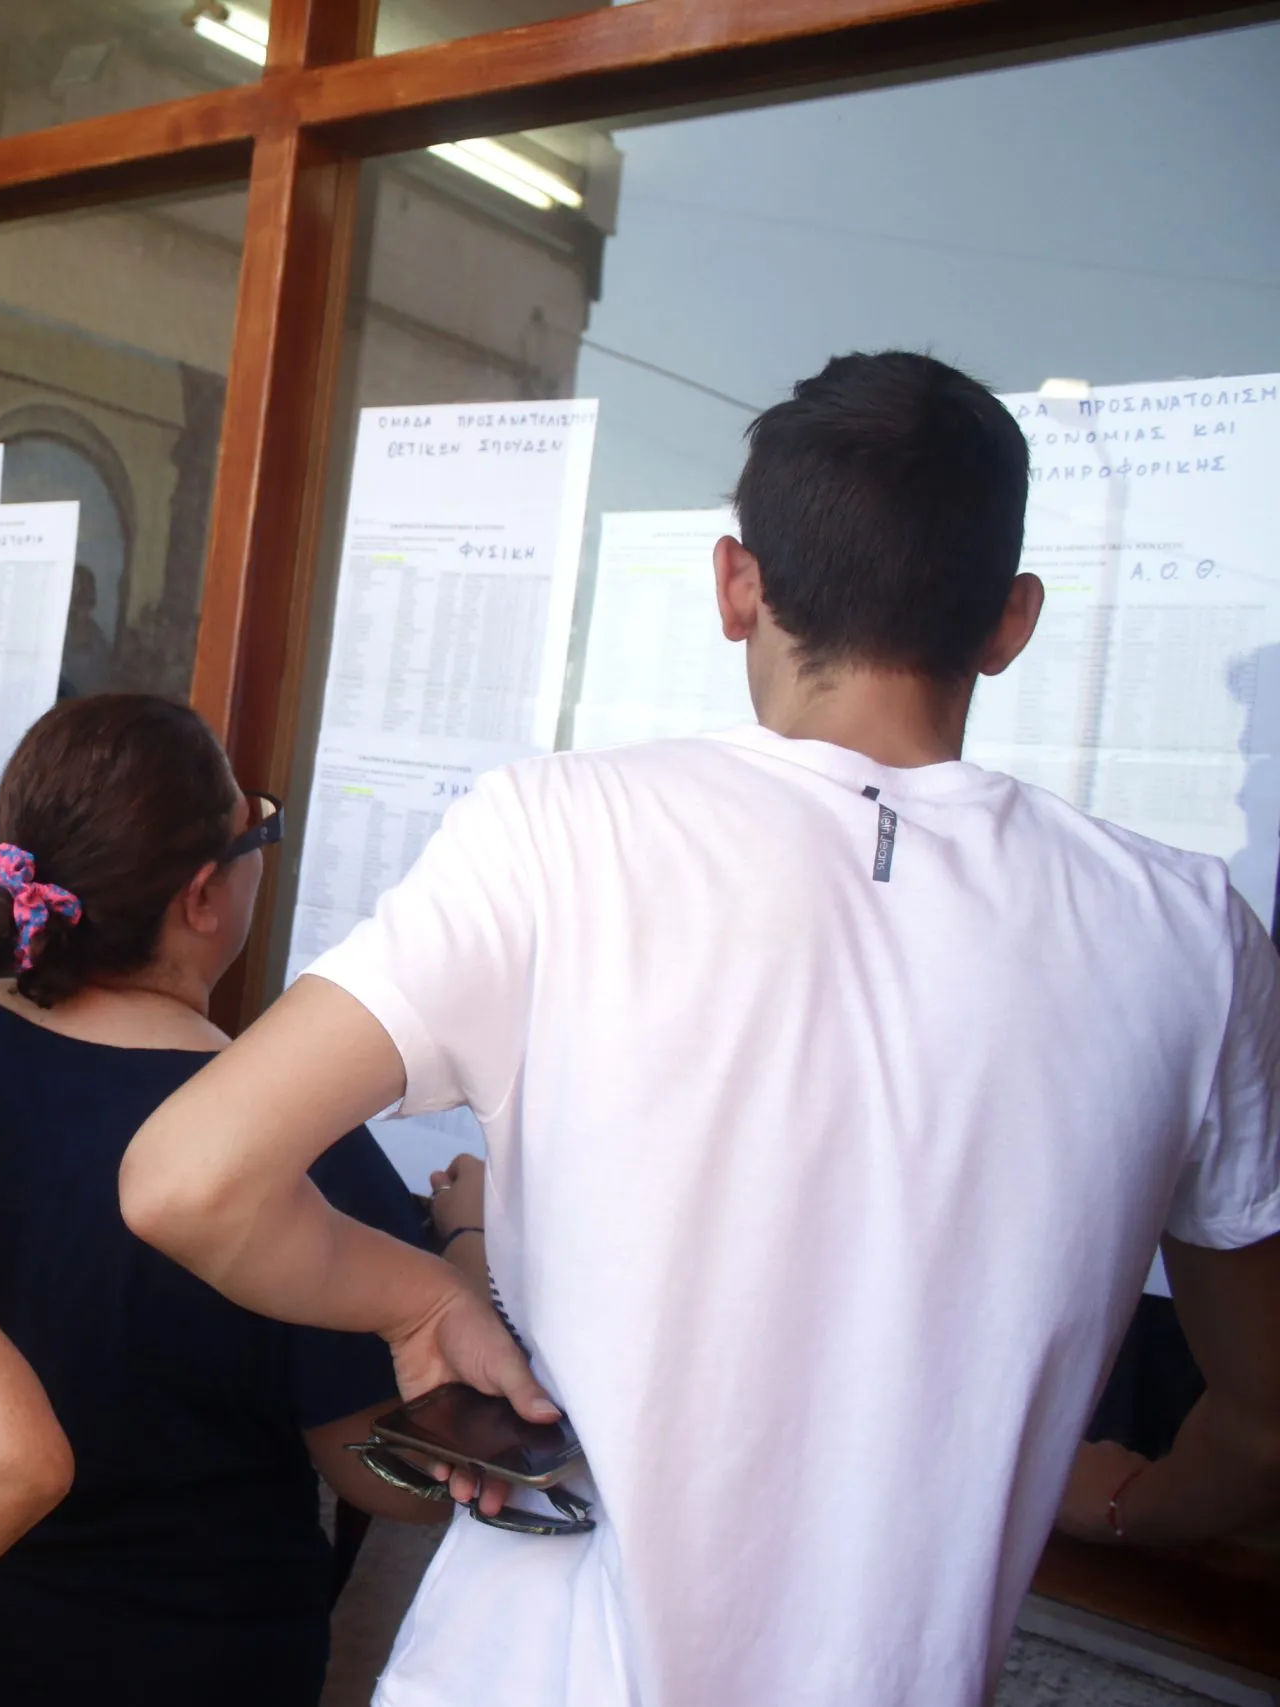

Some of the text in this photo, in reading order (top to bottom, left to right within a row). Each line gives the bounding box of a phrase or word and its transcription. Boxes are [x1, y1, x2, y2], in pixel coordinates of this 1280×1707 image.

[378, 414, 433, 429] ΟΜΑΔΑ
[1015, 402, 1049, 419] ΔΑ
[1026, 420, 1236, 446] ΚΟΝΟΜΙΑΣ ΚΑΙ
[1030, 456, 1225, 482] ΠΛΗΡΟΦΟΡΙΚΗΣ
[458, 541, 537, 560] ΦΥΣΙΚΗ
[876, 836, 893, 870] Jeans
